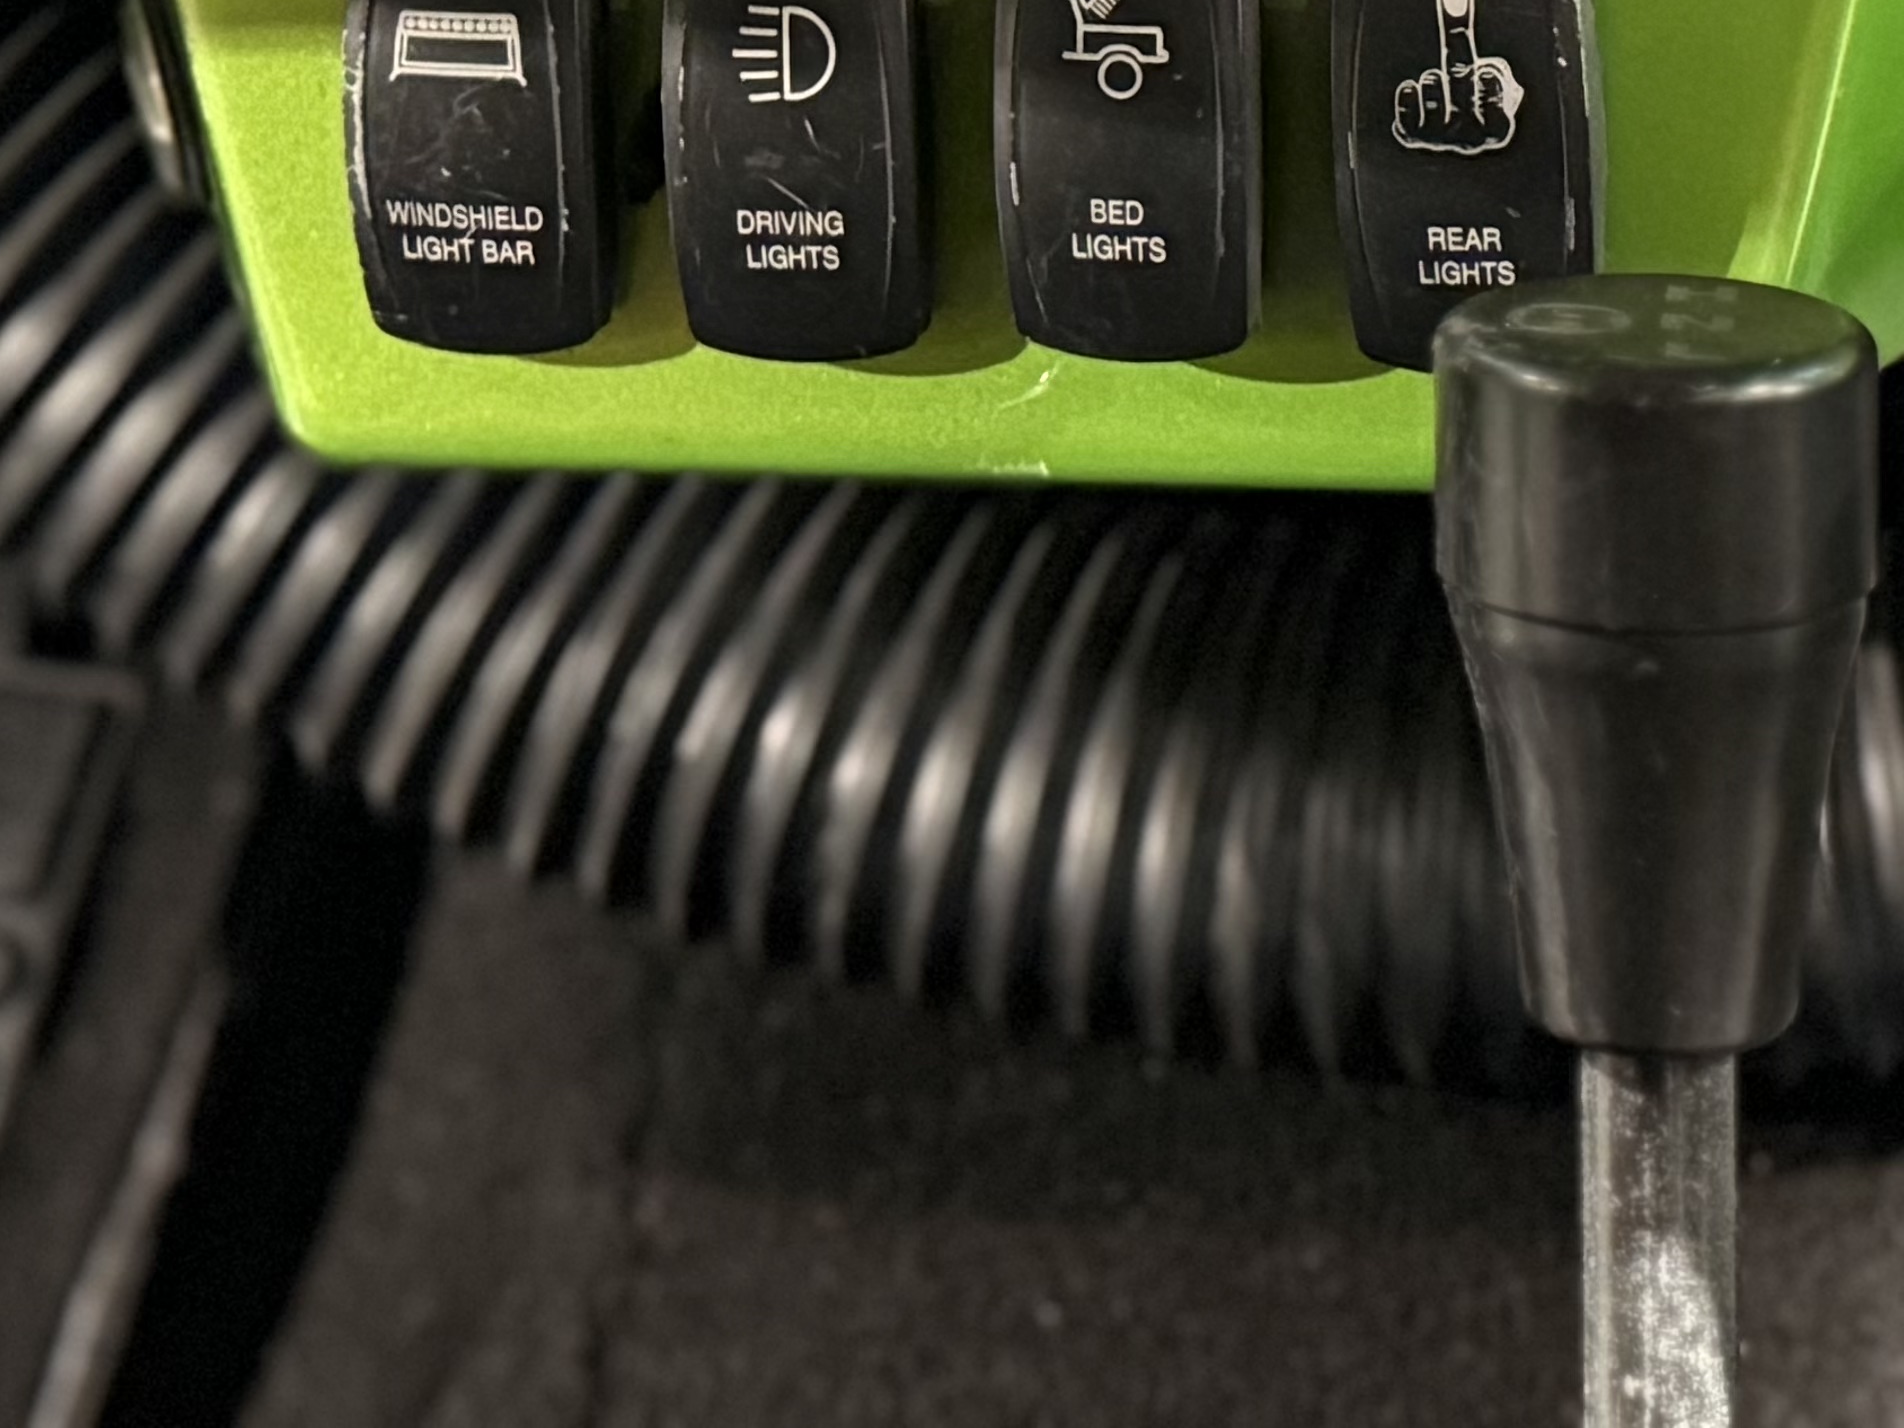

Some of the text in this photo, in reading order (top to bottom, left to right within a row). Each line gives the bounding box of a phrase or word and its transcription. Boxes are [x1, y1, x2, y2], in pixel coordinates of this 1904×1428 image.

[385, 200, 544, 232] WINDSHIELD
[736, 209, 845, 236] DRIVING
[1090, 198, 1144, 225] BED
[402, 233, 536, 266] LIGHT BAR
[1072, 232, 1167, 263] LIGHTS
[1427, 226, 1502, 252] REAR
[746, 244, 840, 270] LIGHTS
[1418, 260, 1516, 286] LIGHTS
